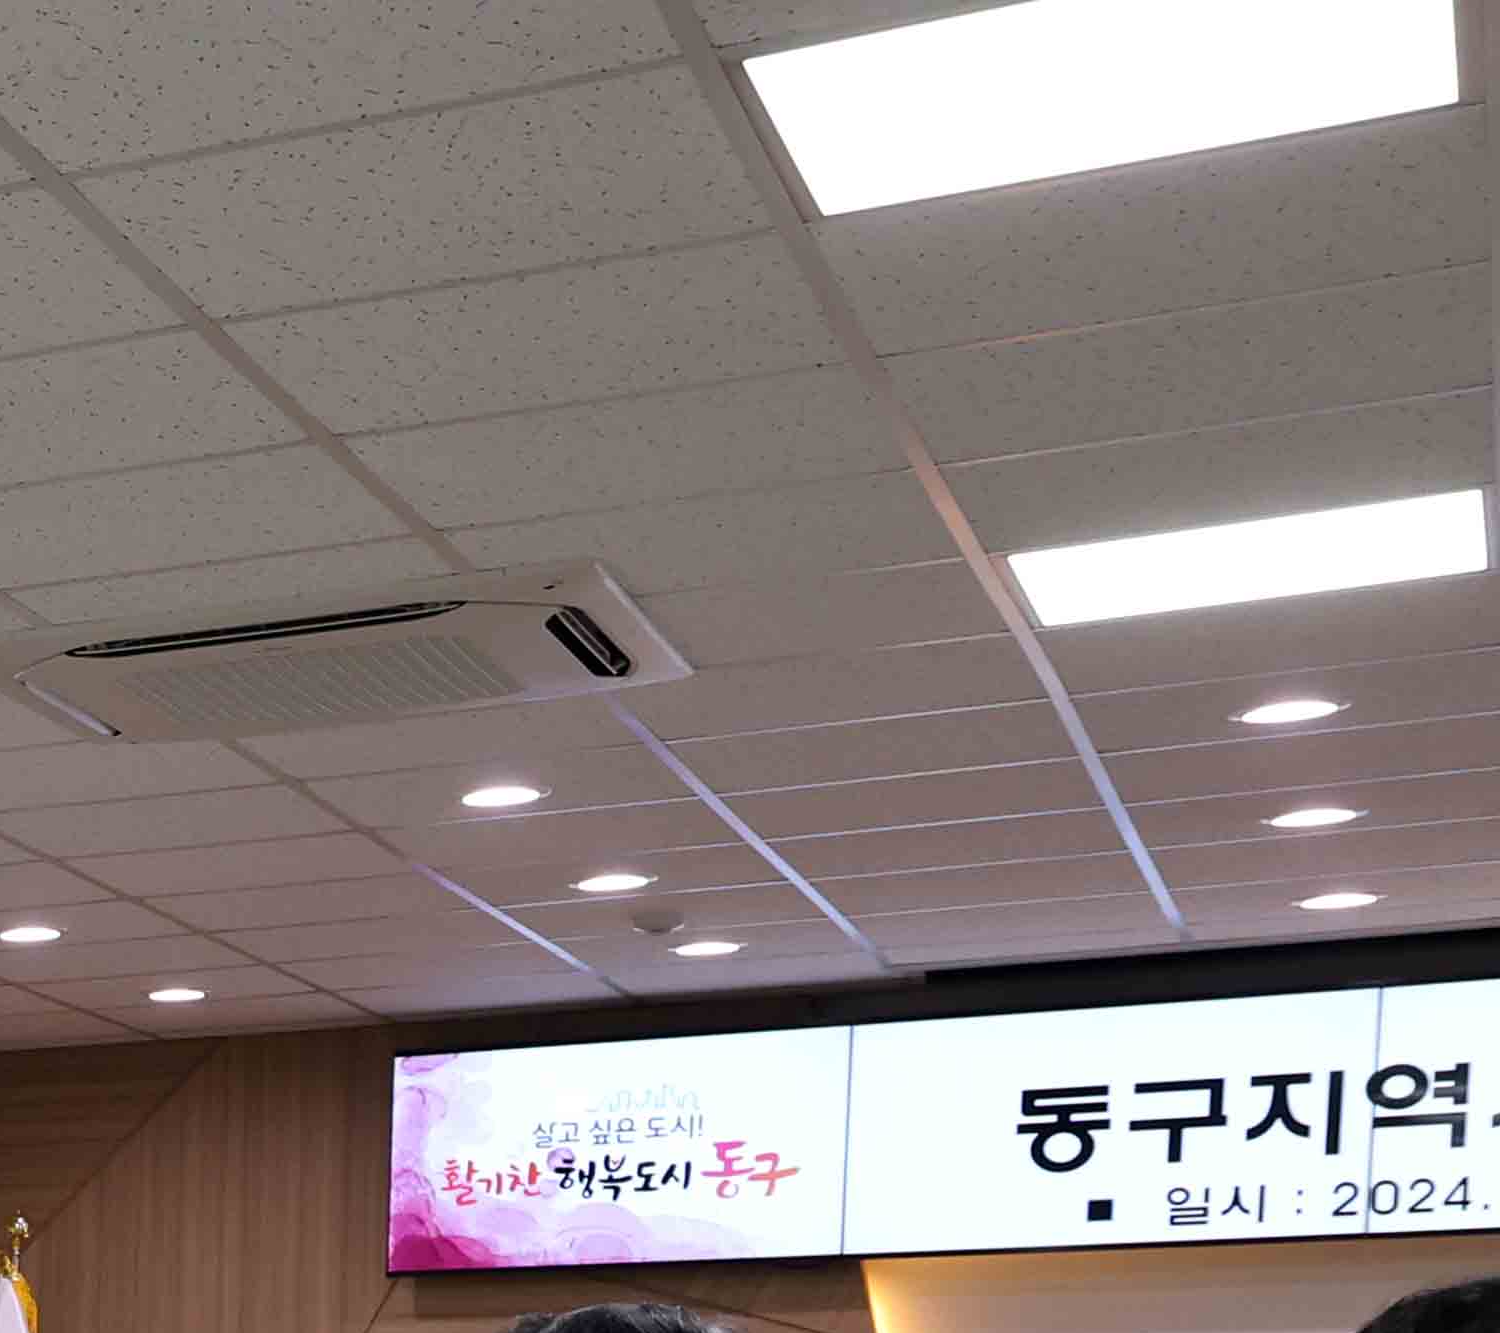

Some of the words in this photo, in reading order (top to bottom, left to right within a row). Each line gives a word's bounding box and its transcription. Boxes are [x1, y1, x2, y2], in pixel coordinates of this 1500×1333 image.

[532, 1121, 580, 1148] 살고
[589, 1117, 636, 1146] 싶은
[645, 1114, 703, 1139] 도시!
[1016, 1062, 1500, 1172] 동구지역
[441, 1158, 541, 1206] 활기찬
[553, 1154, 692, 1201] 행복도시
[701, 1140, 801, 1198] 동구
[1166, 1185, 1266, 1226] 일시
[1331, 1177, 1490, 1217] 2024.
